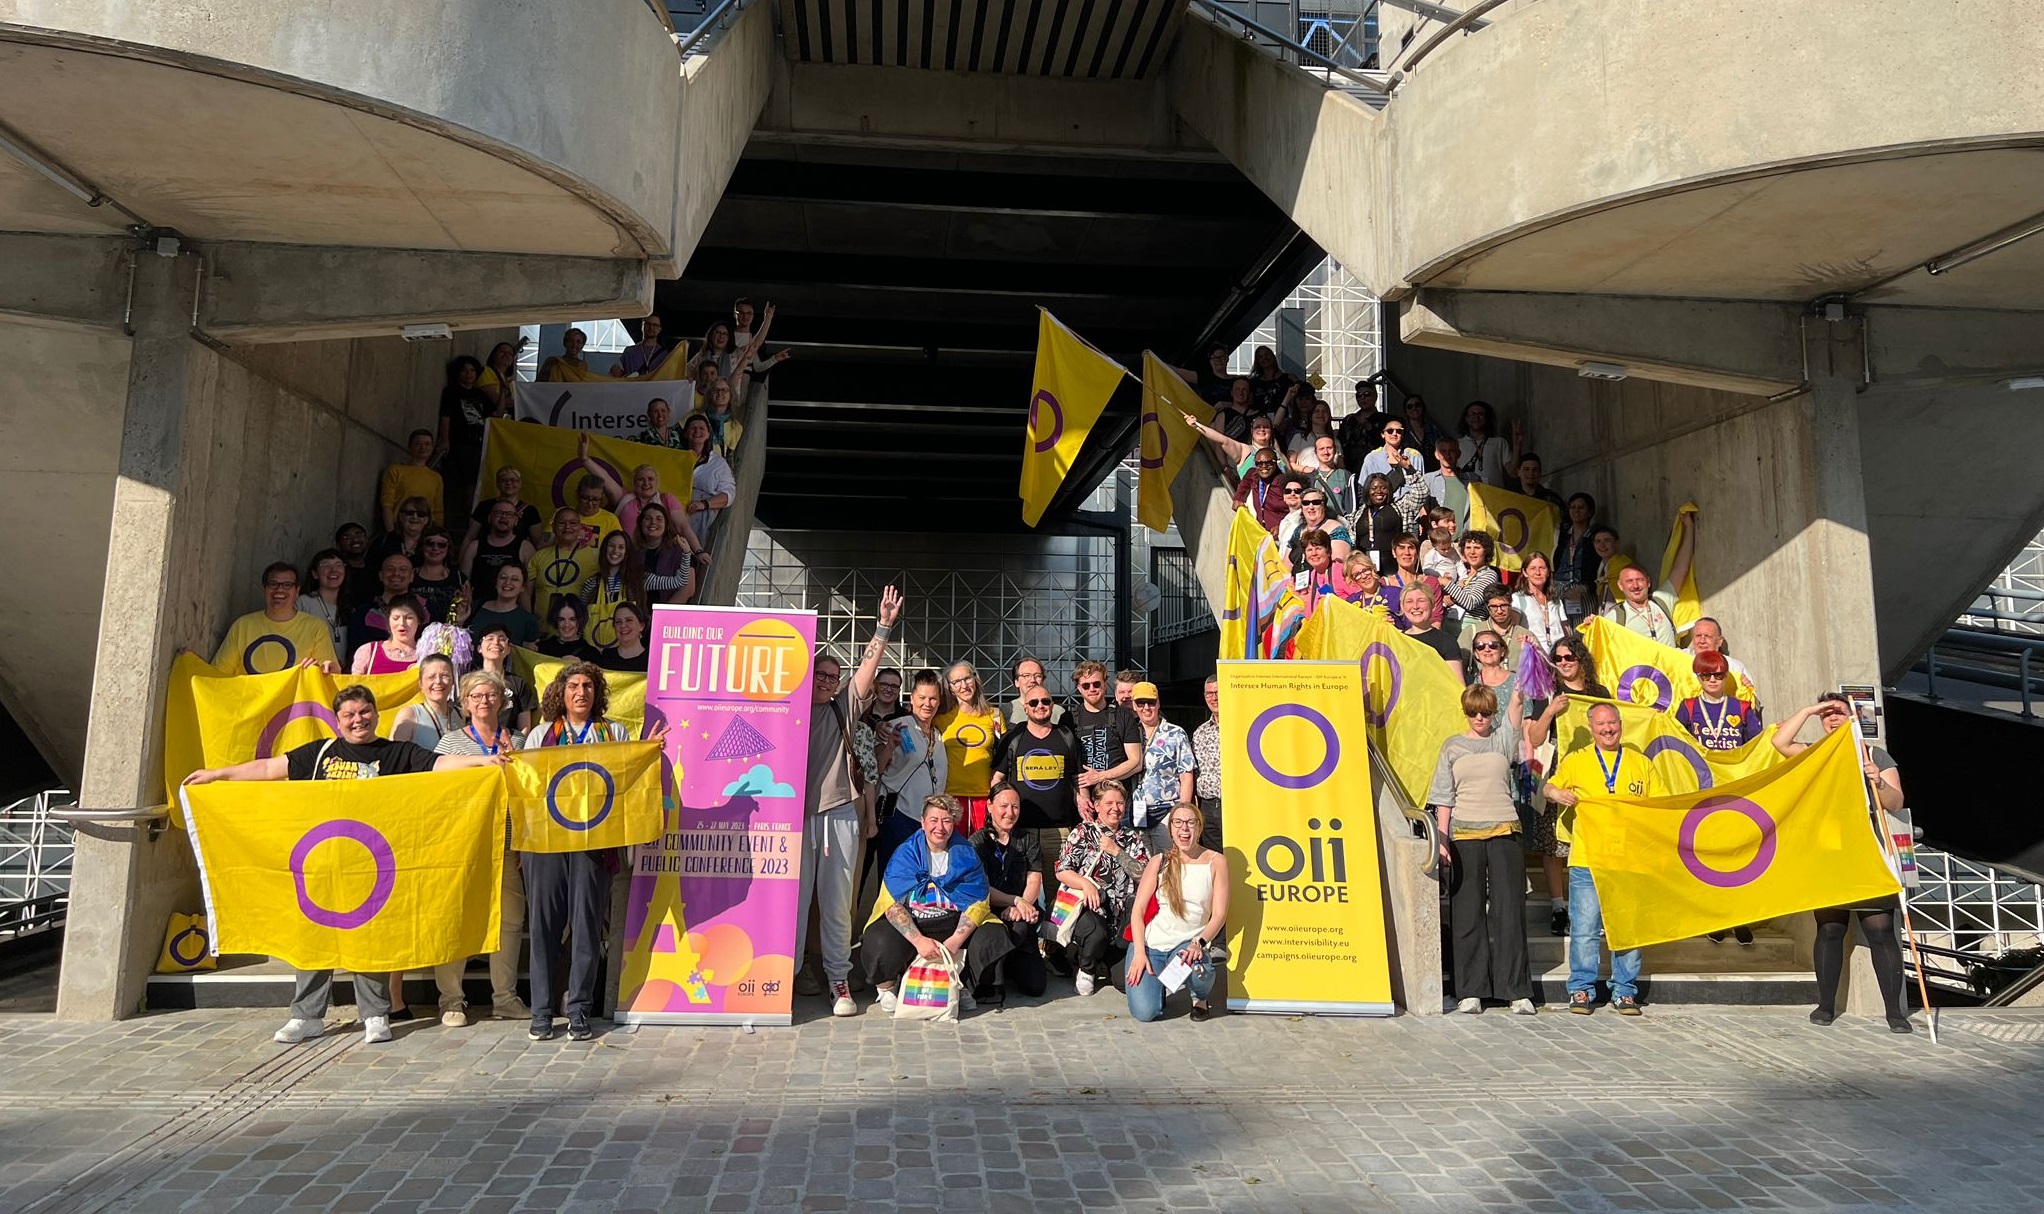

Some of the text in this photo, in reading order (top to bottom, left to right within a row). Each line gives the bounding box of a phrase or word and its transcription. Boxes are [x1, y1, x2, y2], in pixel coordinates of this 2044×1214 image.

[571, 411, 648, 430] Interse
[662, 625, 724, 641] BUILDING OUR
[658, 643, 795, 694] FUTURE
[1289, 682, 1312, 691] Rights
[1322, 683, 1349, 691] Europe
[697, 703, 789, 714] www.oiieurope.org/community
[1701, 726, 1742, 738] ests,
[1628, 780, 1644, 795] oii
[696, 821, 705, 830] 25
[710, 821, 717, 830] 27
[731, 821, 745, 830] 2023
[771, 822, 792, 831] FRANCE
[664, 833, 788, 853] COMMUNITY EVENT &
[1255, 818, 1347, 883] oii
[641, 855, 788, 875] PUBLIC CONFERENCE 2023
[1256, 884, 1349, 904] EUROPE
[1266, 925, 1344, 935] www.oiieurope.org
[1262, 938, 1350, 949] www.intervisibility.eu
[1256, 952, 1358, 964] campaigns.oiieurope.org
[738, 979, 755, 992] oii
